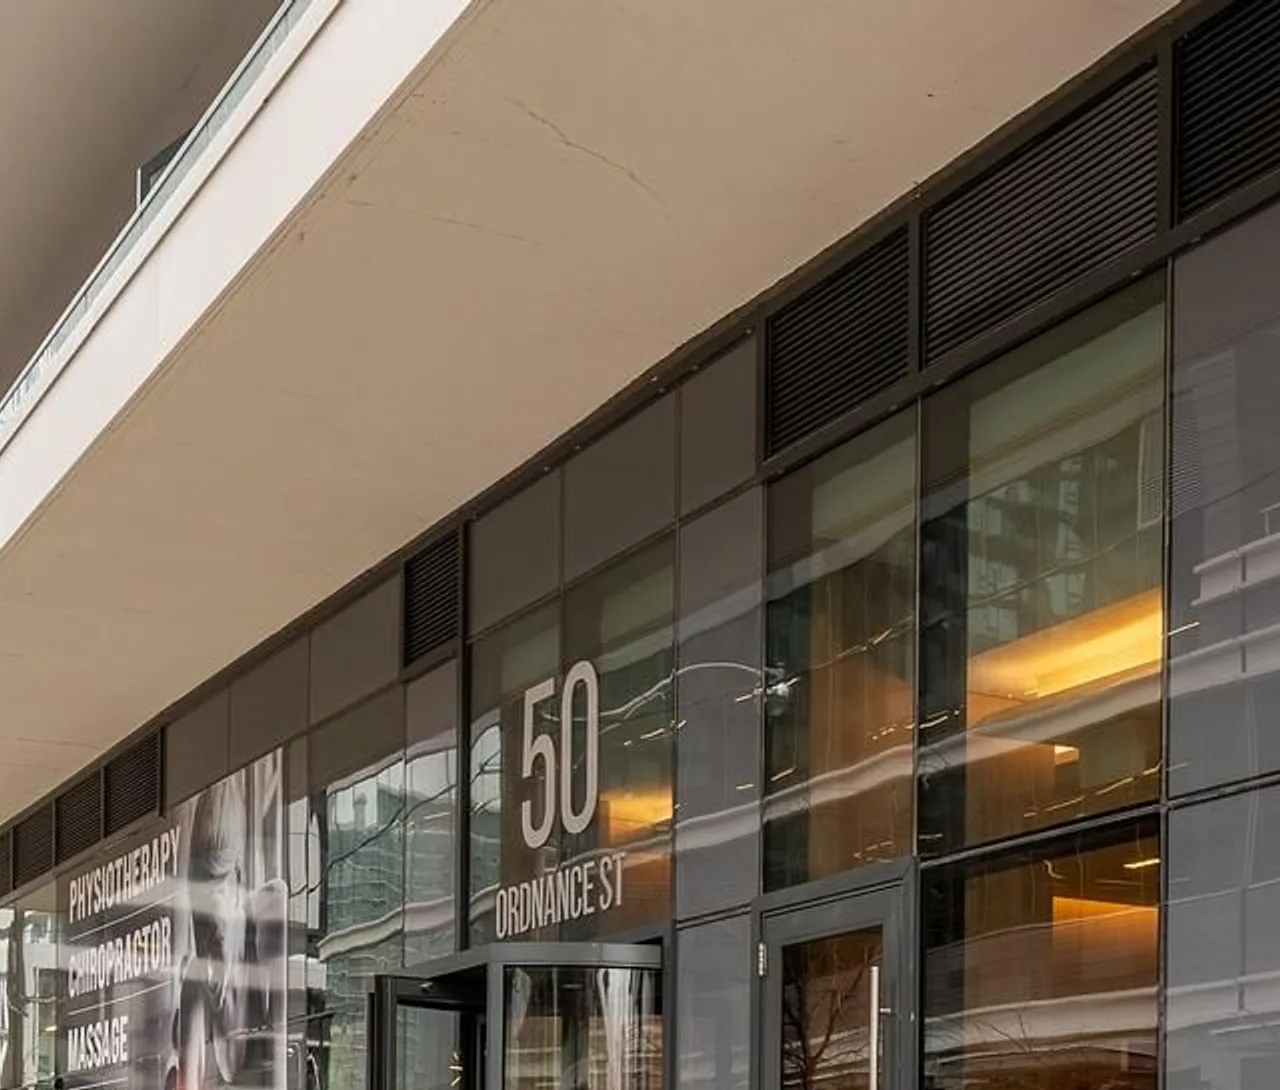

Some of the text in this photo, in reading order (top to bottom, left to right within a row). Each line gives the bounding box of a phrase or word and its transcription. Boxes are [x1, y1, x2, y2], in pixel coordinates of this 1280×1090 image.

[522, 660, 599, 849] 50
[70, 826, 180, 923] PHYSIOTHERAPY
[495, 852, 626, 939] ORDNANCE ST
[68, 917, 172, 998] CHIROPRACTOR
[68, 1016, 128, 1072] MASSAGE
